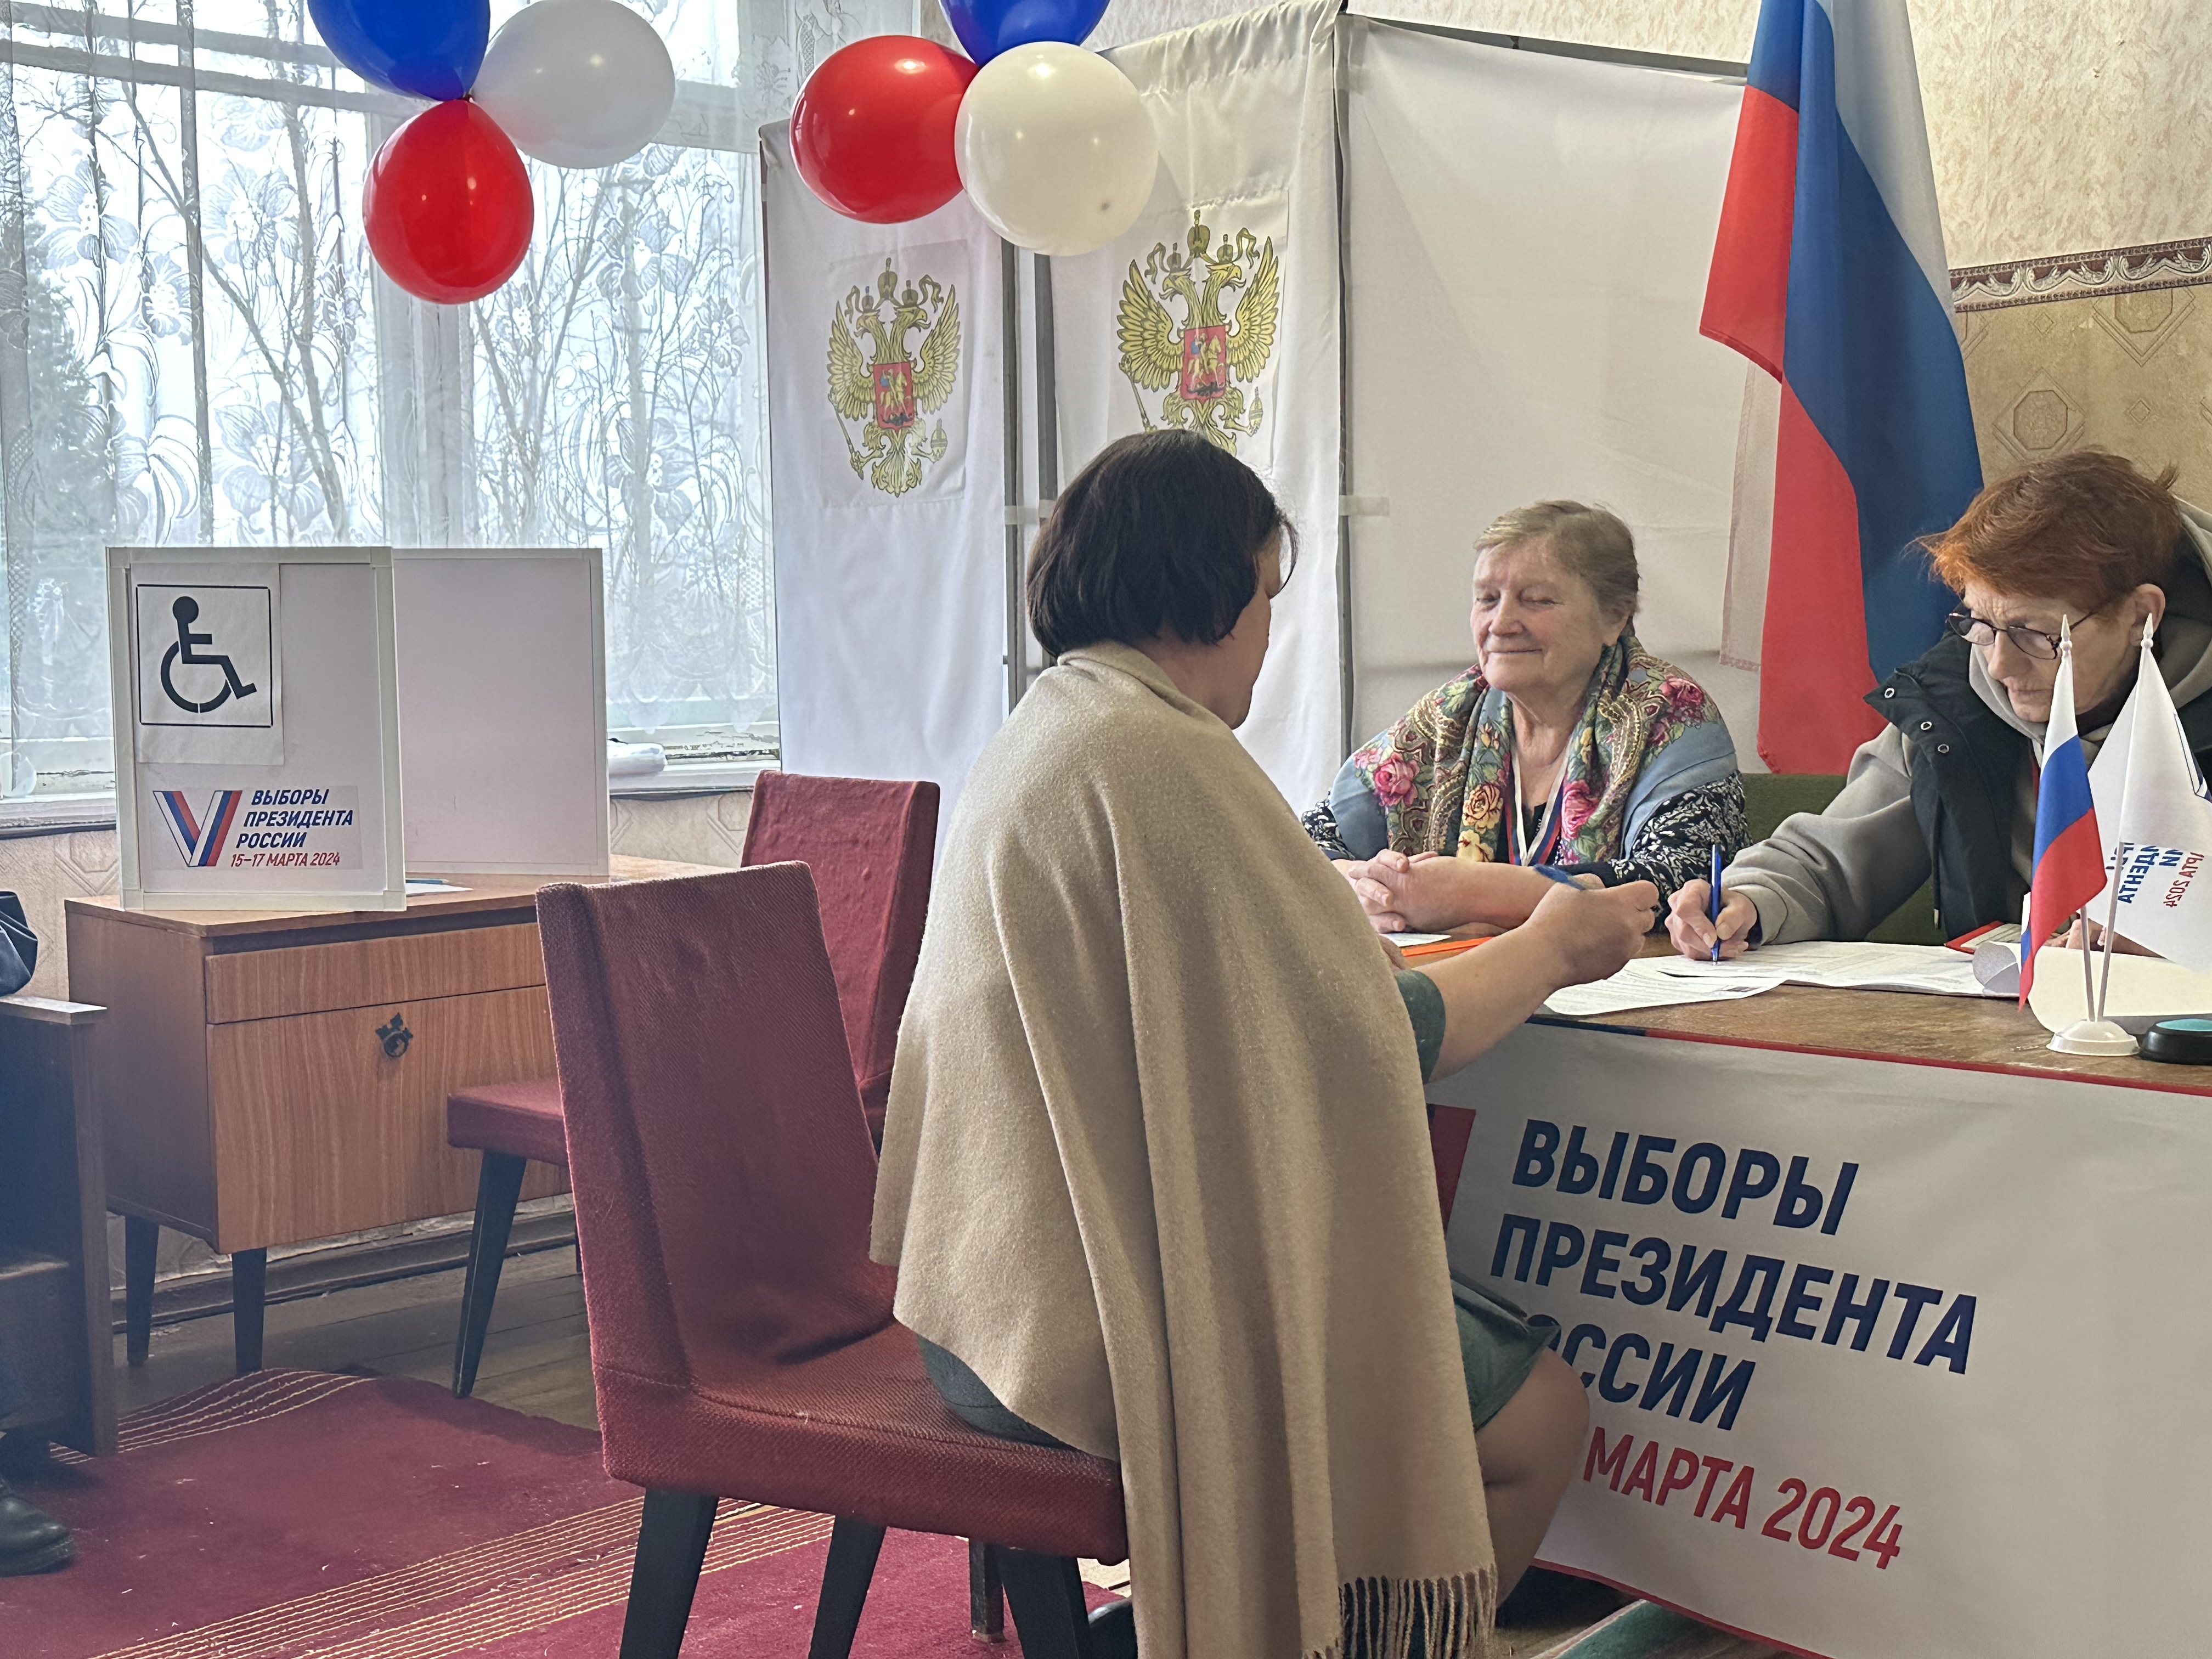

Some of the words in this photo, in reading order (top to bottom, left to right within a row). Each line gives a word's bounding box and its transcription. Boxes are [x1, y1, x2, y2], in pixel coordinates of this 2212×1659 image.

[243, 809, 354, 829] ПРЕЗИДЕНТА
[251, 788, 330, 805] ВЫБОРЫ
[235, 832, 307, 849] РОССИИ
[266, 853, 308, 867] МАРТА
[309, 851, 341, 866] 2024
[1511, 1118, 1860, 1236] ВЫБОРЫ
[1490, 1213, 1977, 1375] ПРЕЗИДЕНТА
[1527, 1313, 1756, 1431] ССИИ
[1583, 1426, 1755, 1530] МАРТА
[1761, 1477, 1904, 1570] 2024
